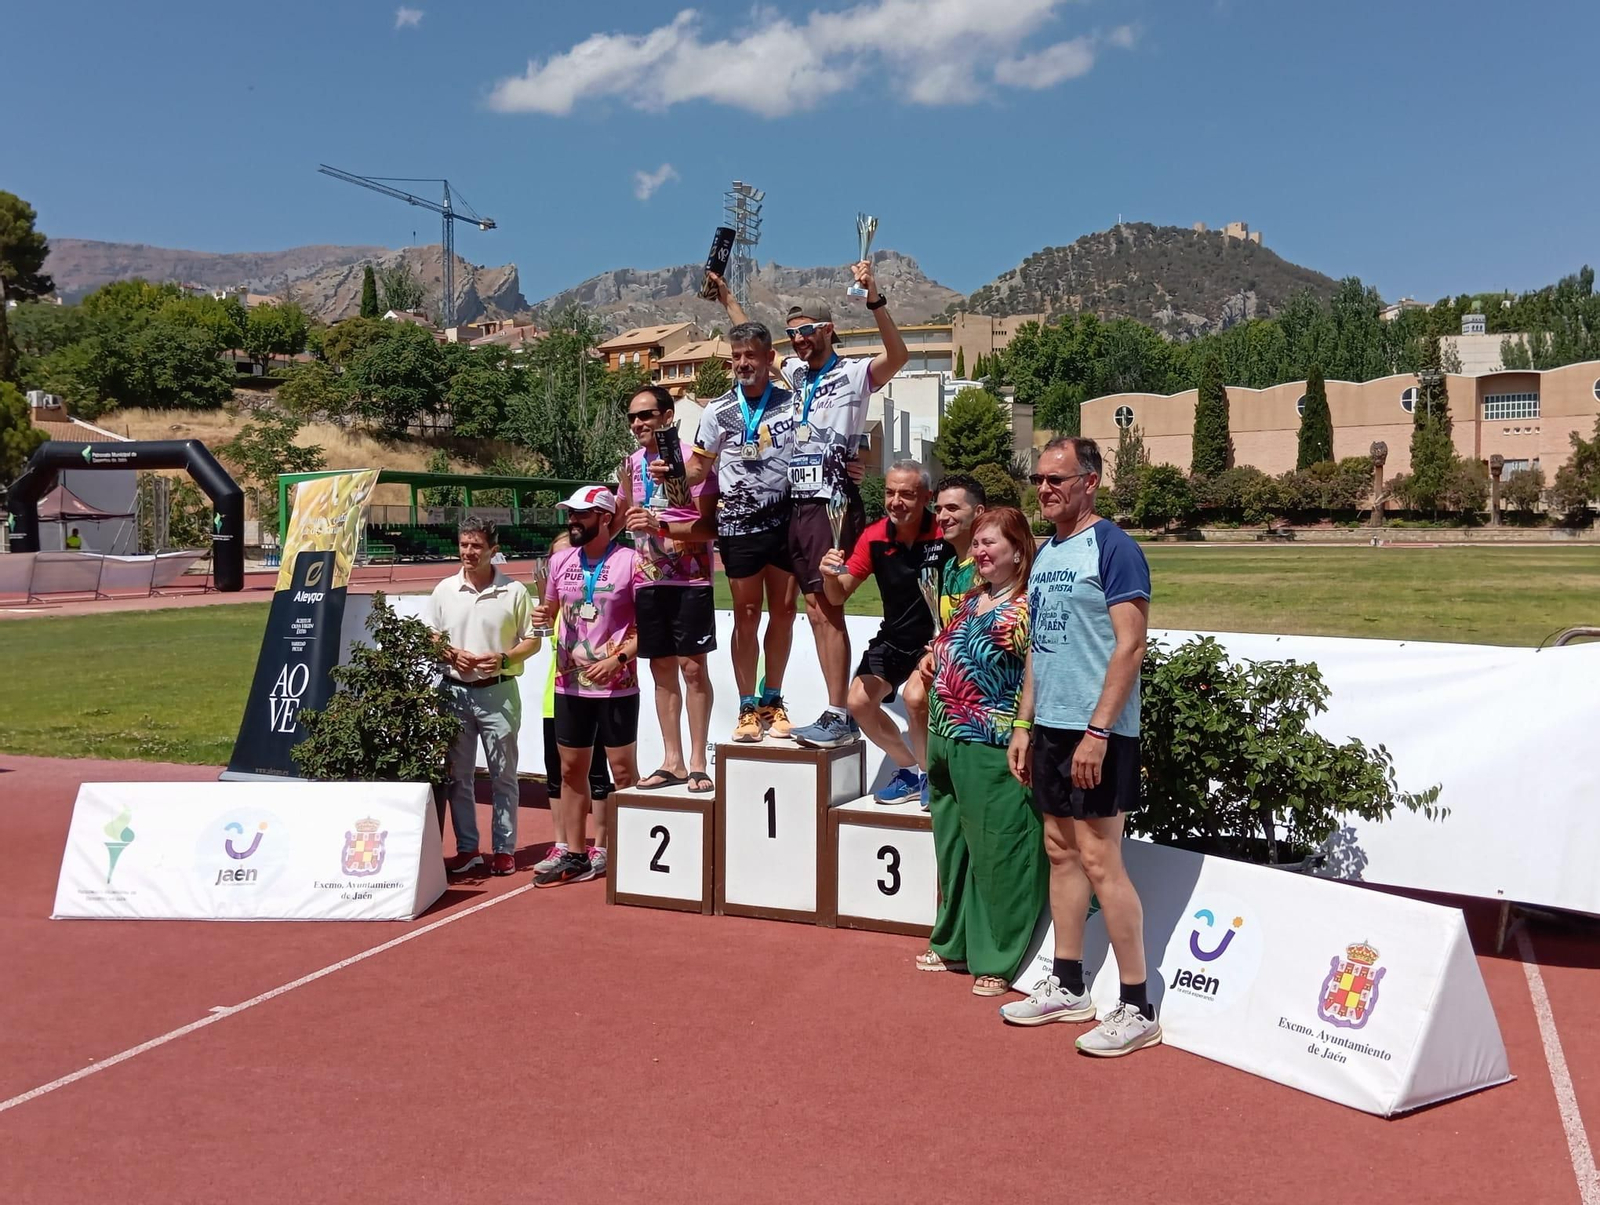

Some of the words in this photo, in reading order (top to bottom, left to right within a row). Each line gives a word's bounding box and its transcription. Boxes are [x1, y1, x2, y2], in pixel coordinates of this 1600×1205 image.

[790, 467, 818, 484] 104-1
[924, 543, 943, 555] Sprint
[1033, 567, 1077, 585] MARATÓN
[293, 591, 324, 605] Aleygo
[269, 663, 310, 698] AO
[269, 697, 300, 733] VE
[764, 787, 777, 839] 1
[650, 825, 671, 873] 2
[877, 845, 901, 896] 3
[313, 881, 344, 889] Excmo.
[346, 881, 404, 890] Ayuntamiento
[341, 891, 351, 900] de
[352, 892, 373, 900] Jaén
[1278, 1016, 1314, 1037] Excmo.
[1316, 1029, 1392, 1061] Ayuntamiento
[1307, 1043, 1320, 1055] de
[1321, 1047, 1347, 1064] Jaén
